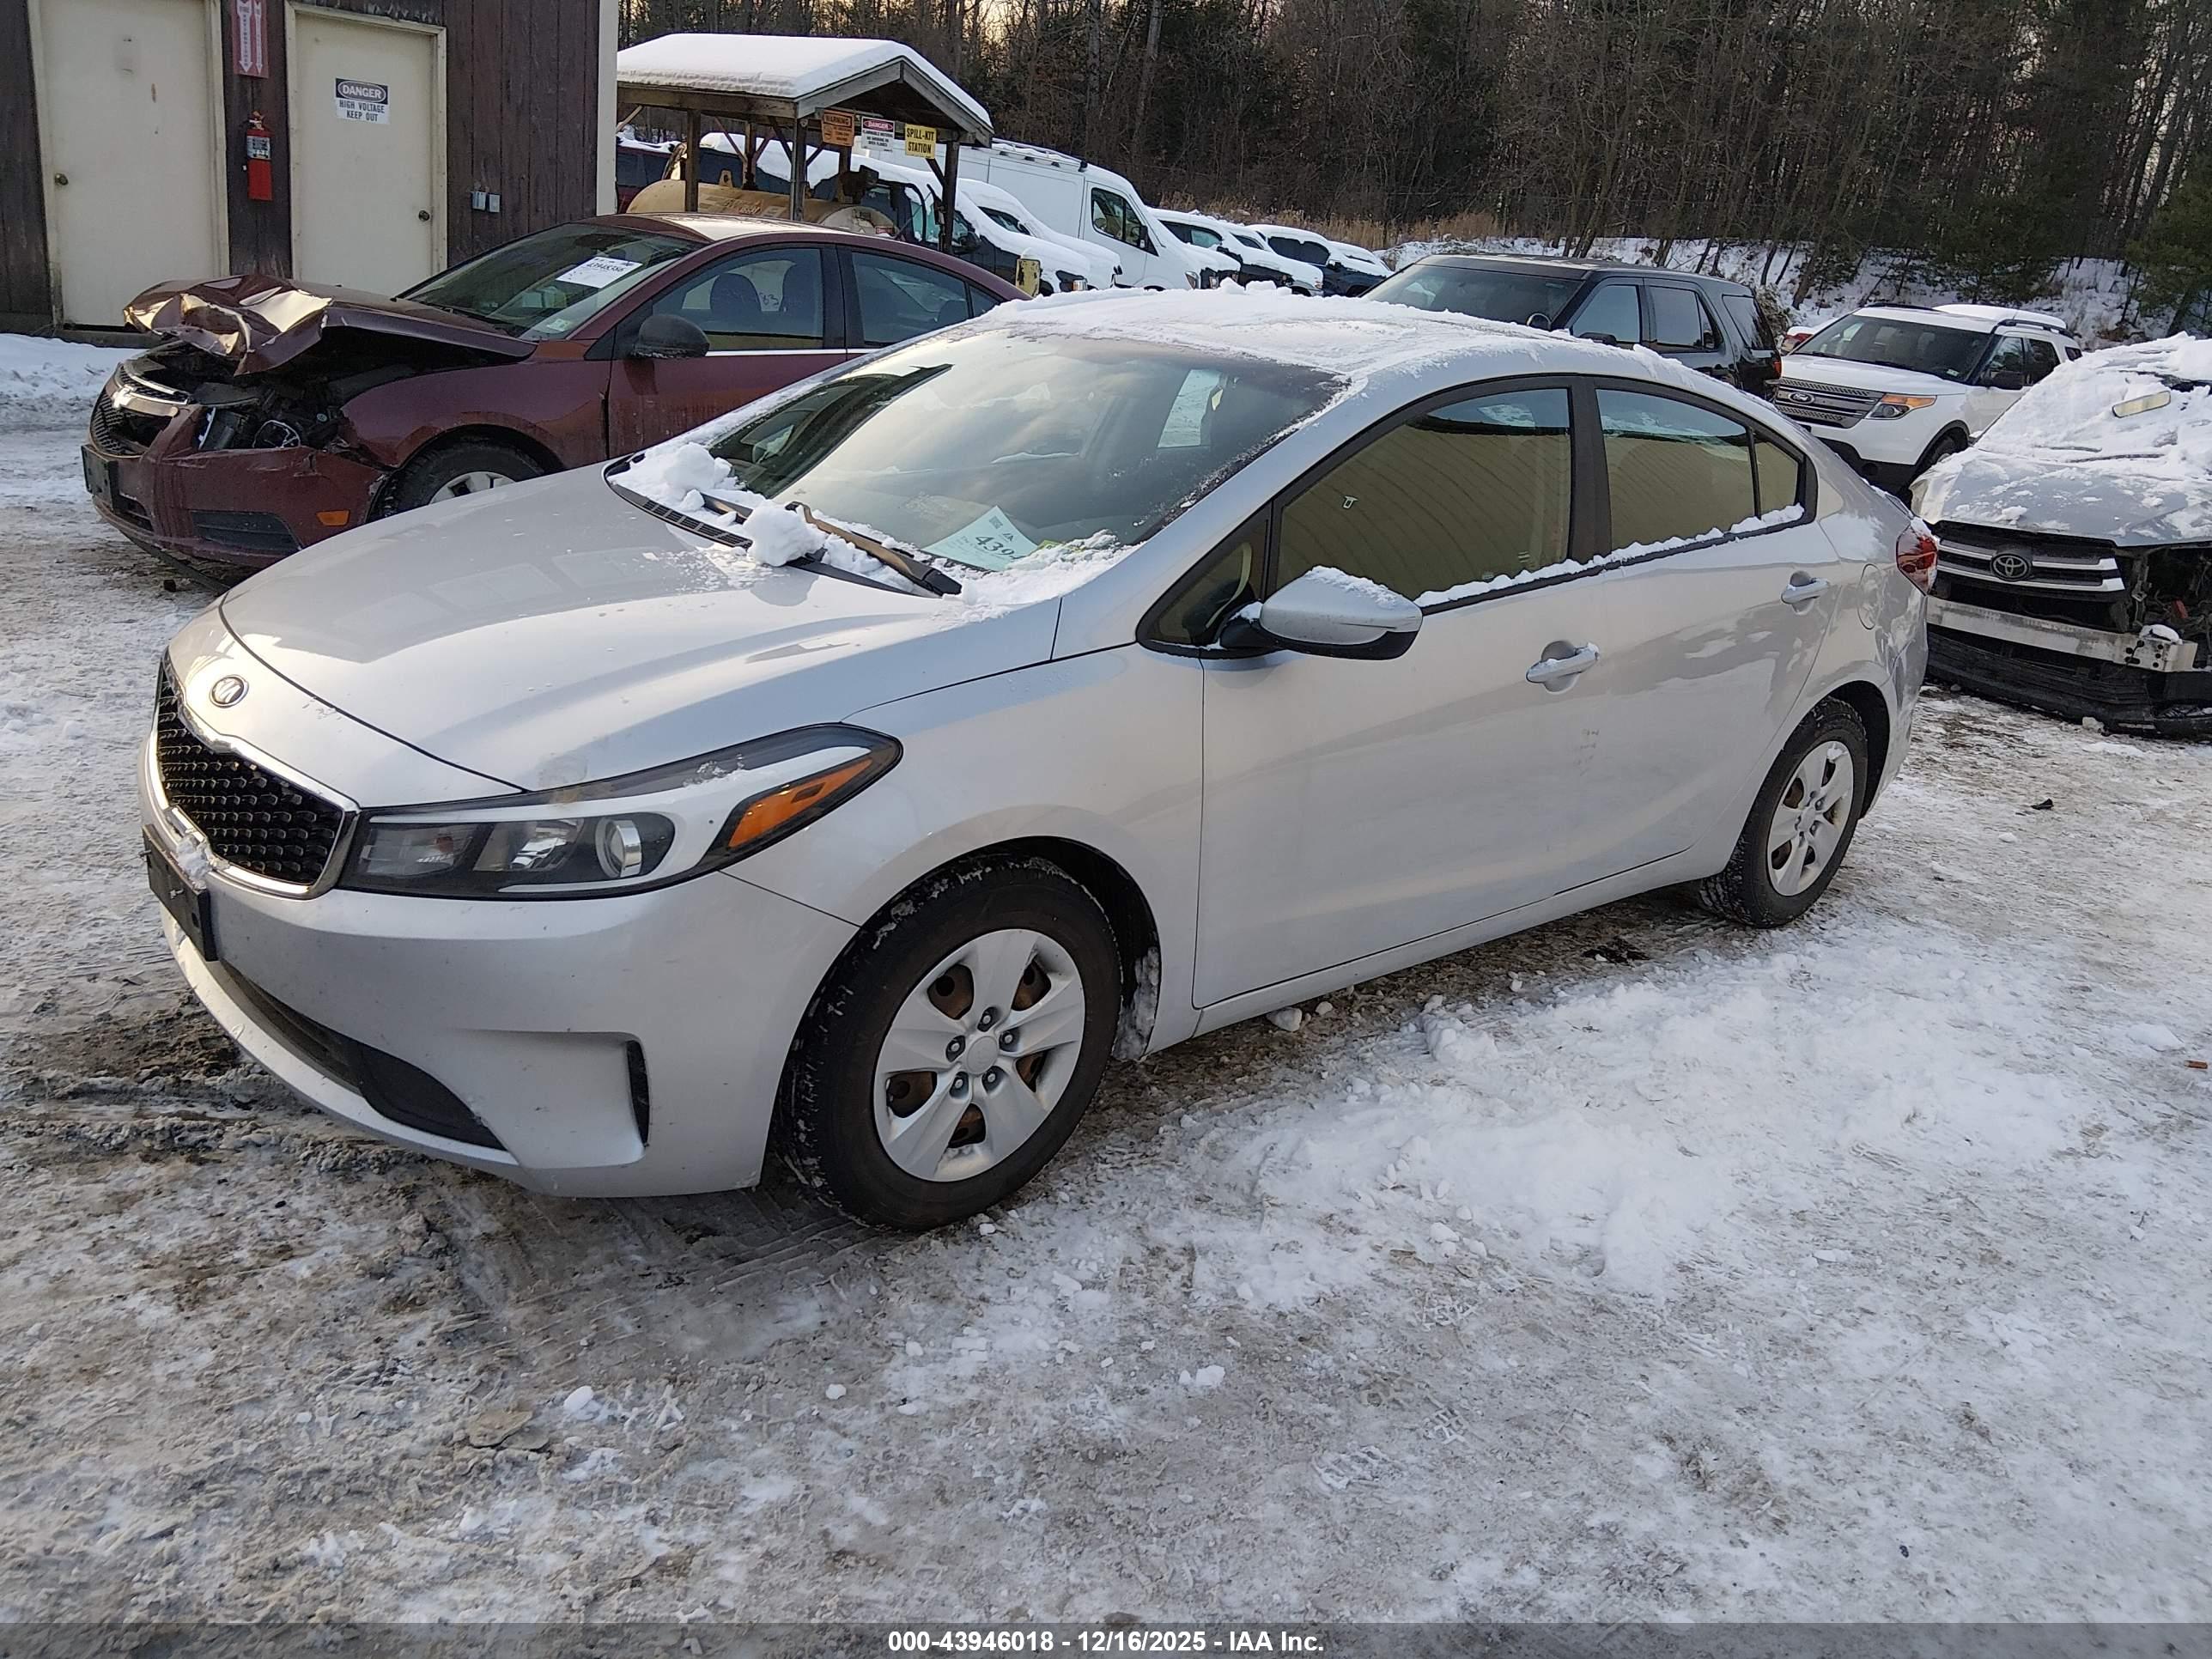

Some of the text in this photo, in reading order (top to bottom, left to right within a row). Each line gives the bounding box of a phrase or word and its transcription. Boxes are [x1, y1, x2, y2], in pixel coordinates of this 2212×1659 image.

[343, 84, 381, 99] DANGER
[339, 100, 385, 113] HIGH VOLTAGE
[346, 110, 378, 121] KEEP OUT
[907, 128, 934, 141] SPILL-KIT
[908, 142, 932, 154] STATION
